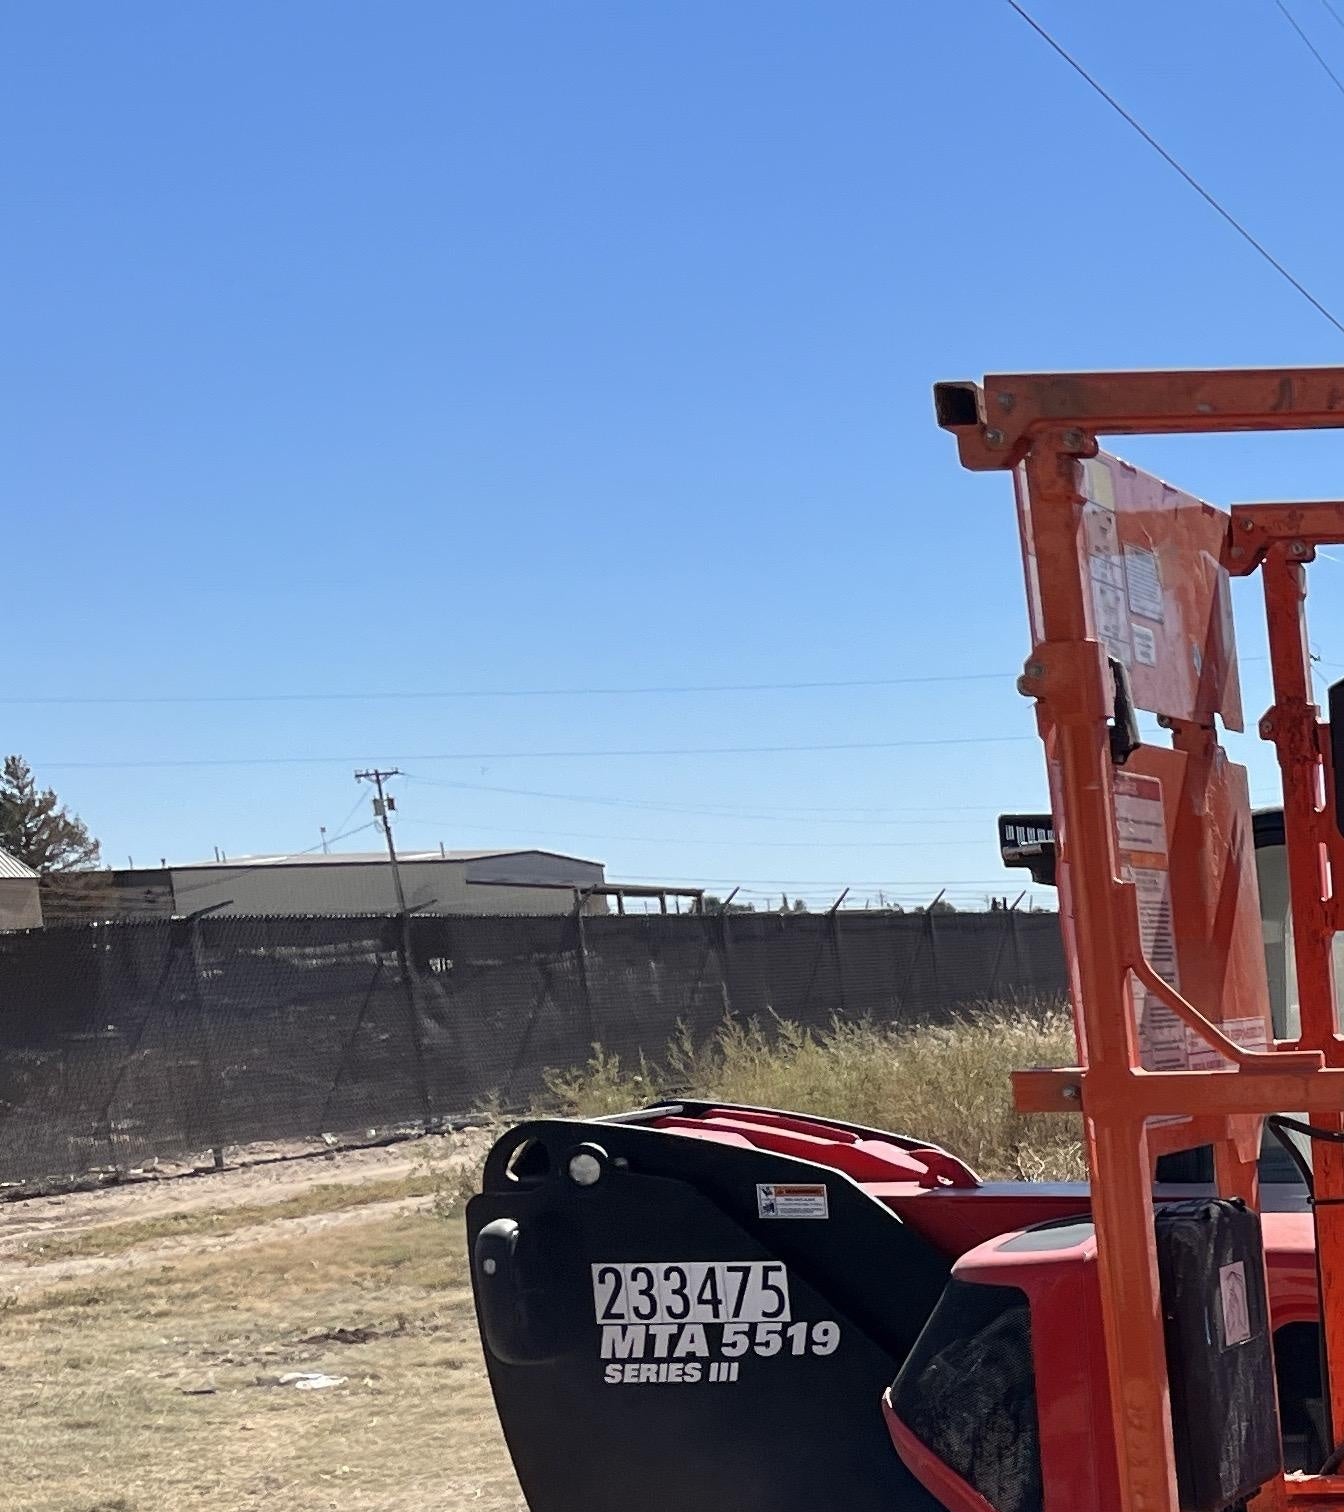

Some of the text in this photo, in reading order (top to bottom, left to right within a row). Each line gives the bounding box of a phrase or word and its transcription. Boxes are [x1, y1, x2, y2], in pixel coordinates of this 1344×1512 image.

[597, 1265, 787, 1321] 233475
[600, 1320, 841, 1359] MTA 5519
[603, 1361, 739, 1384] SERIES III
